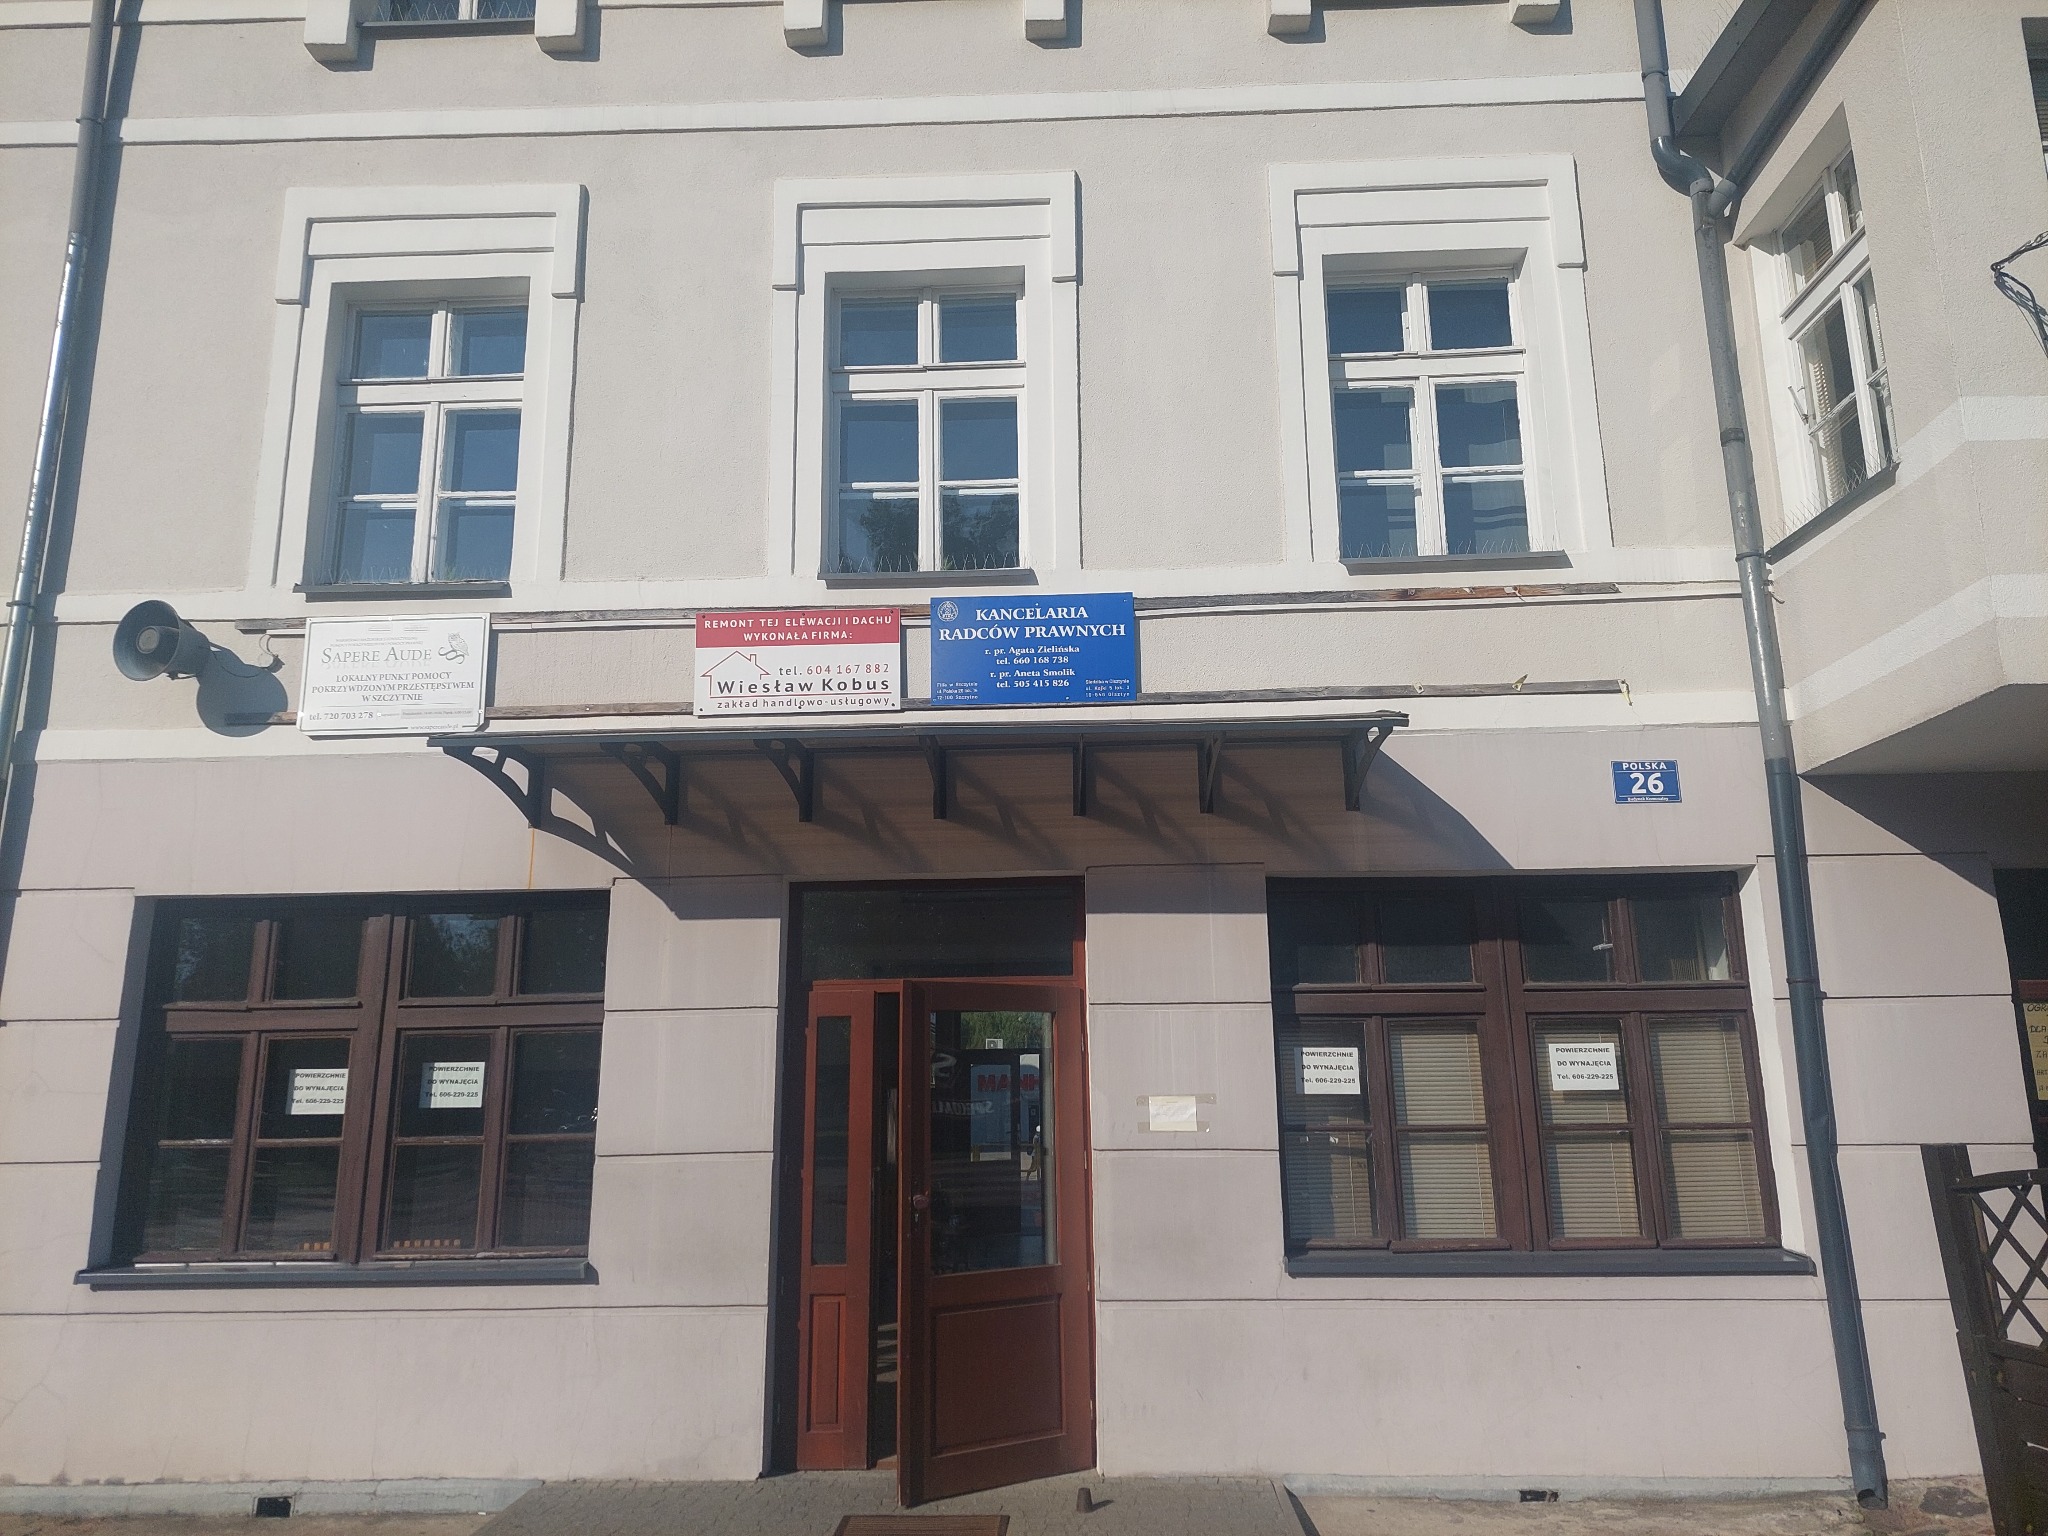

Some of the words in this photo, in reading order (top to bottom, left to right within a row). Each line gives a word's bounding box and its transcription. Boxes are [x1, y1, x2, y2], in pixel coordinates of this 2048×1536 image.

[976, 607, 1088, 621] KANCELARIA
[705, 620, 754, 628] REMONT
[761, 619, 779, 627] TEJ
[785, 617, 841, 626] ELEWACJI
[845, 617, 848, 625] I
[853, 616, 892, 625] DACHU
[744, 631, 808, 641] WYKONAŁA
[812, 631, 853, 640] FIRMA:
[939, 624, 1020, 640] RADCÓW
[1025, 624, 1126, 639] PRAWNYCH
[994, 648, 1006, 656] pr.
[1009, 646, 1035, 655] Agata
[1038, 645, 1080, 653] Zielińska
[1052, 656, 1069, 664] 738
[779, 666, 803, 676] tel.
[807, 665, 831, 675] 604
[837, 665, 860, 674] 167
[866, 663, 889, 673] 882
[999, 671, 1011, 679] pr.
[1014, 669, 1040, 677] Aneta
[1044, 668, 1075, 676] Smolik
[336, 674, 378, 682] LOKALNY
[379, 673, 411, 681] PUNKT
[412, 672, 452, 680] POMOCY
[312, 684, 396, 693] POKRZYWDZONYM
[398, 682, 475, 691] PRZESTĘPSTWEM
[718, 680, 814, 694] Wiesław
[822, 678, 889, 691] Kobus
[997, 680, 1011, 688] tel.
[1013, 680, 1030, 688] 505
[1053, 679, 1069, 687] 826
[372, 693, 423, 701] SZCZYTNIE
[718, 699, 758, 709] zakład
[763, 696, 890, 708] handlowo-usługowy
[309, 712, 322, 720] tel.
[324, 712, 340, 720] 720
[341, 712, 357, 720] 703
[358, 711, 373, 719] 278
[1623, 762, 1667, 770] POLSKA
[1630, 773, 1664, 793] 26
[2027, 1004, 2048, 1012] OGR
